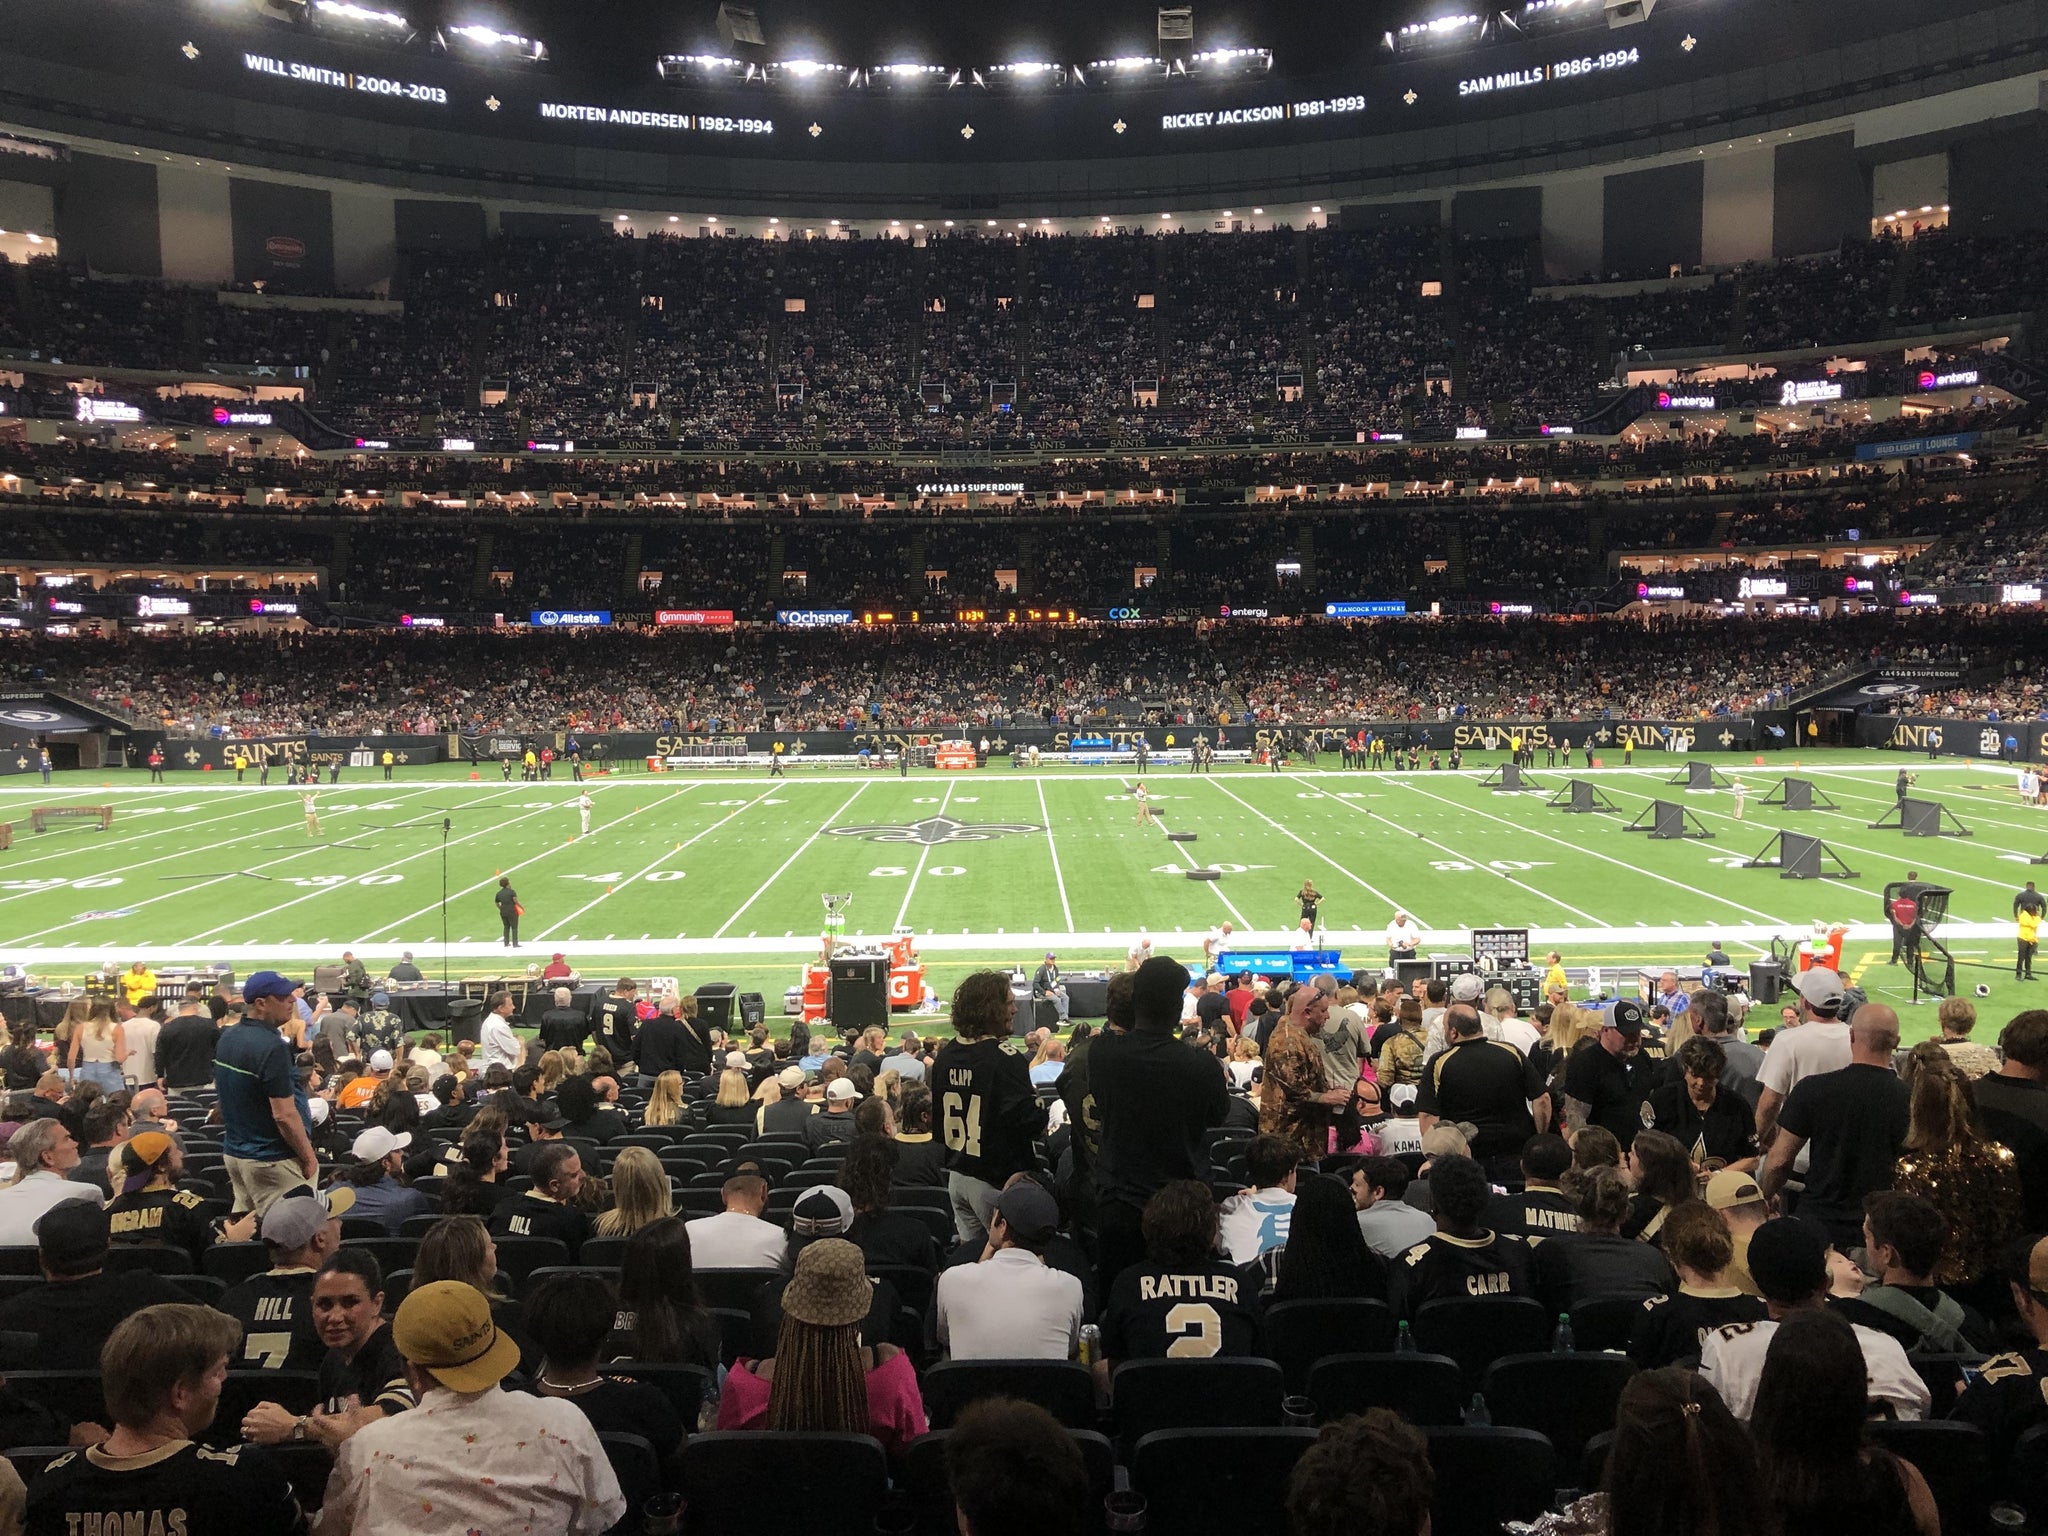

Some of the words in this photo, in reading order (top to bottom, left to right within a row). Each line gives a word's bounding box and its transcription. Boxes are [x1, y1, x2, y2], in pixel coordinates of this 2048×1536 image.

[1459, 76, 1493, 95] SAM
[1496, 67, 1543, 88] MILLS
[1553, 47, 1640, 79] 1986-1994
[245, 53, 288, 76] WILL
[290, 63, 345, 87] SMITH
[356, 75, 447, 103] 2004-2013
[1162, 112, 1214, 129] RICKEY
[1216, 105, 1283, 125] JACKSON
[1293, 95, 1366, 117] 1981-1993
[542, 103, 606, 122] MORTEN
[609, 110, 689, 129] ANDERSEN
[699, 116, 774, 134] 1982-1994
[1936, 370, 1978, 386] entergy
[1671, 395, 1715, 409] entergy
[231, 413, 272, 425] entergy
[619, 441, 656, 449] SAINTS
[1110, 439, 1147, 448] SAINTS
[1191, 437, 1228, 446] SAINTS
[1272, 435, 1311, 444] SAINTS
[703, 442, 740, 450] SAINTS
[785, 442, 822, 450] SAINTS
[867, 442, 904, 451] SAINTS
[1029, 441, 1066, 450] SAINTS
[1876, 444, 1894, 455] BUD
[1894, 441, 1921, 453] LIGHT
[1925, 436, 1959, 450] LOUNGE
[1768, 452, 1809, 463] SAINTS
[1599, 463, 1636, 473] SAINTS
[1682, 458, 1721, 469] SAINTS
[34, 465, 75, 475] SAINTS
[1435, 471, 1471, 480] SAINTS
[1516, 468, 1552, 477] SAINTS
[125, 472, 166, 482] SAINTS
[216, 477, 255, 486] SAINTS
[1278, 476, 1312, 484] SAINTS
[1355, 473, 1391, 482] SAINTS
[302, 480, 340, 489] SAINTS
[386, 481, 423, 490] SAINTS
[466, 481, 503, 490] SAINTS
[547, 482, 583, 491] SAINTS
[625, 483, 660, 492] SAINTS
[702, 484, 736, 493] SAINTS
[777, 484, 811, 493] SAINTS
[852, 484, 886, 493] SAINTS
[916, 483, 967, 493] CAESARS
[967, 483, 1025, 492] SUPERDOME
[1054, 482, 1087, 490] SAINTS
[1128, 481, 1162, 489] SAINTS
[1201, 479, 1236, 487] SAINTS
[1648, 586, 1684, 598] entergy
[264, 602, 297, 614] entergy
[1109, 607, 1140, 620] COX
[1165, 607, 1201, 616] SAINTS
[1232, 607, 1268, 618] entergy
[1338, 605, 1369, 613] HANCOCK
[1371, 604, 1406, 612] WHITNEY
[1501, 604, 1533, 614] entergy
[413, 617, 444, 627] entergy
[559, 612, 600, 624] Allstate
[615, 612, 652, 622] SAINTS
[659, 611, 705, 623] Community
[788, 611, 849, 624] Ochsner
[1454, 725, 1548, 745] SAINTS
[1980, 732, 1999, 752] 20
[223, 740, 307, 765] SAINTS
[311, 752, 344, 763] SAINTS
[869, 865, 967, 876] 50
[1150, 862, 1248, 874] 40
[1428, 860, 1532, 871] 30
[295, 874, 404, 886] 30
[584, 871, 687, 882] 40
[1, 877, 124, 890] 20
[891, 976, 909, 999] G
[602, 1013, 614, 1036] 9
[949, 1067, 973, 1087] CLAPP
[943, 1091, 982, 1157] 64
[1394, 1140, 1421, 1152] KAMA
[110, 1206, 164, 1234] INGRAM
[508, 1215, 532, 1237] HILL
[1140, 1274, 1239, 1304] RATTLER
[1466, 1271, 1511, 1296] CARR
[254, 1297, 293, 1321] HILL
[1165, 1302, 1222, 1358] 2
[244, 1331, 293, 1369] 7
[65, 1507, 189, 1536] THOMAS
